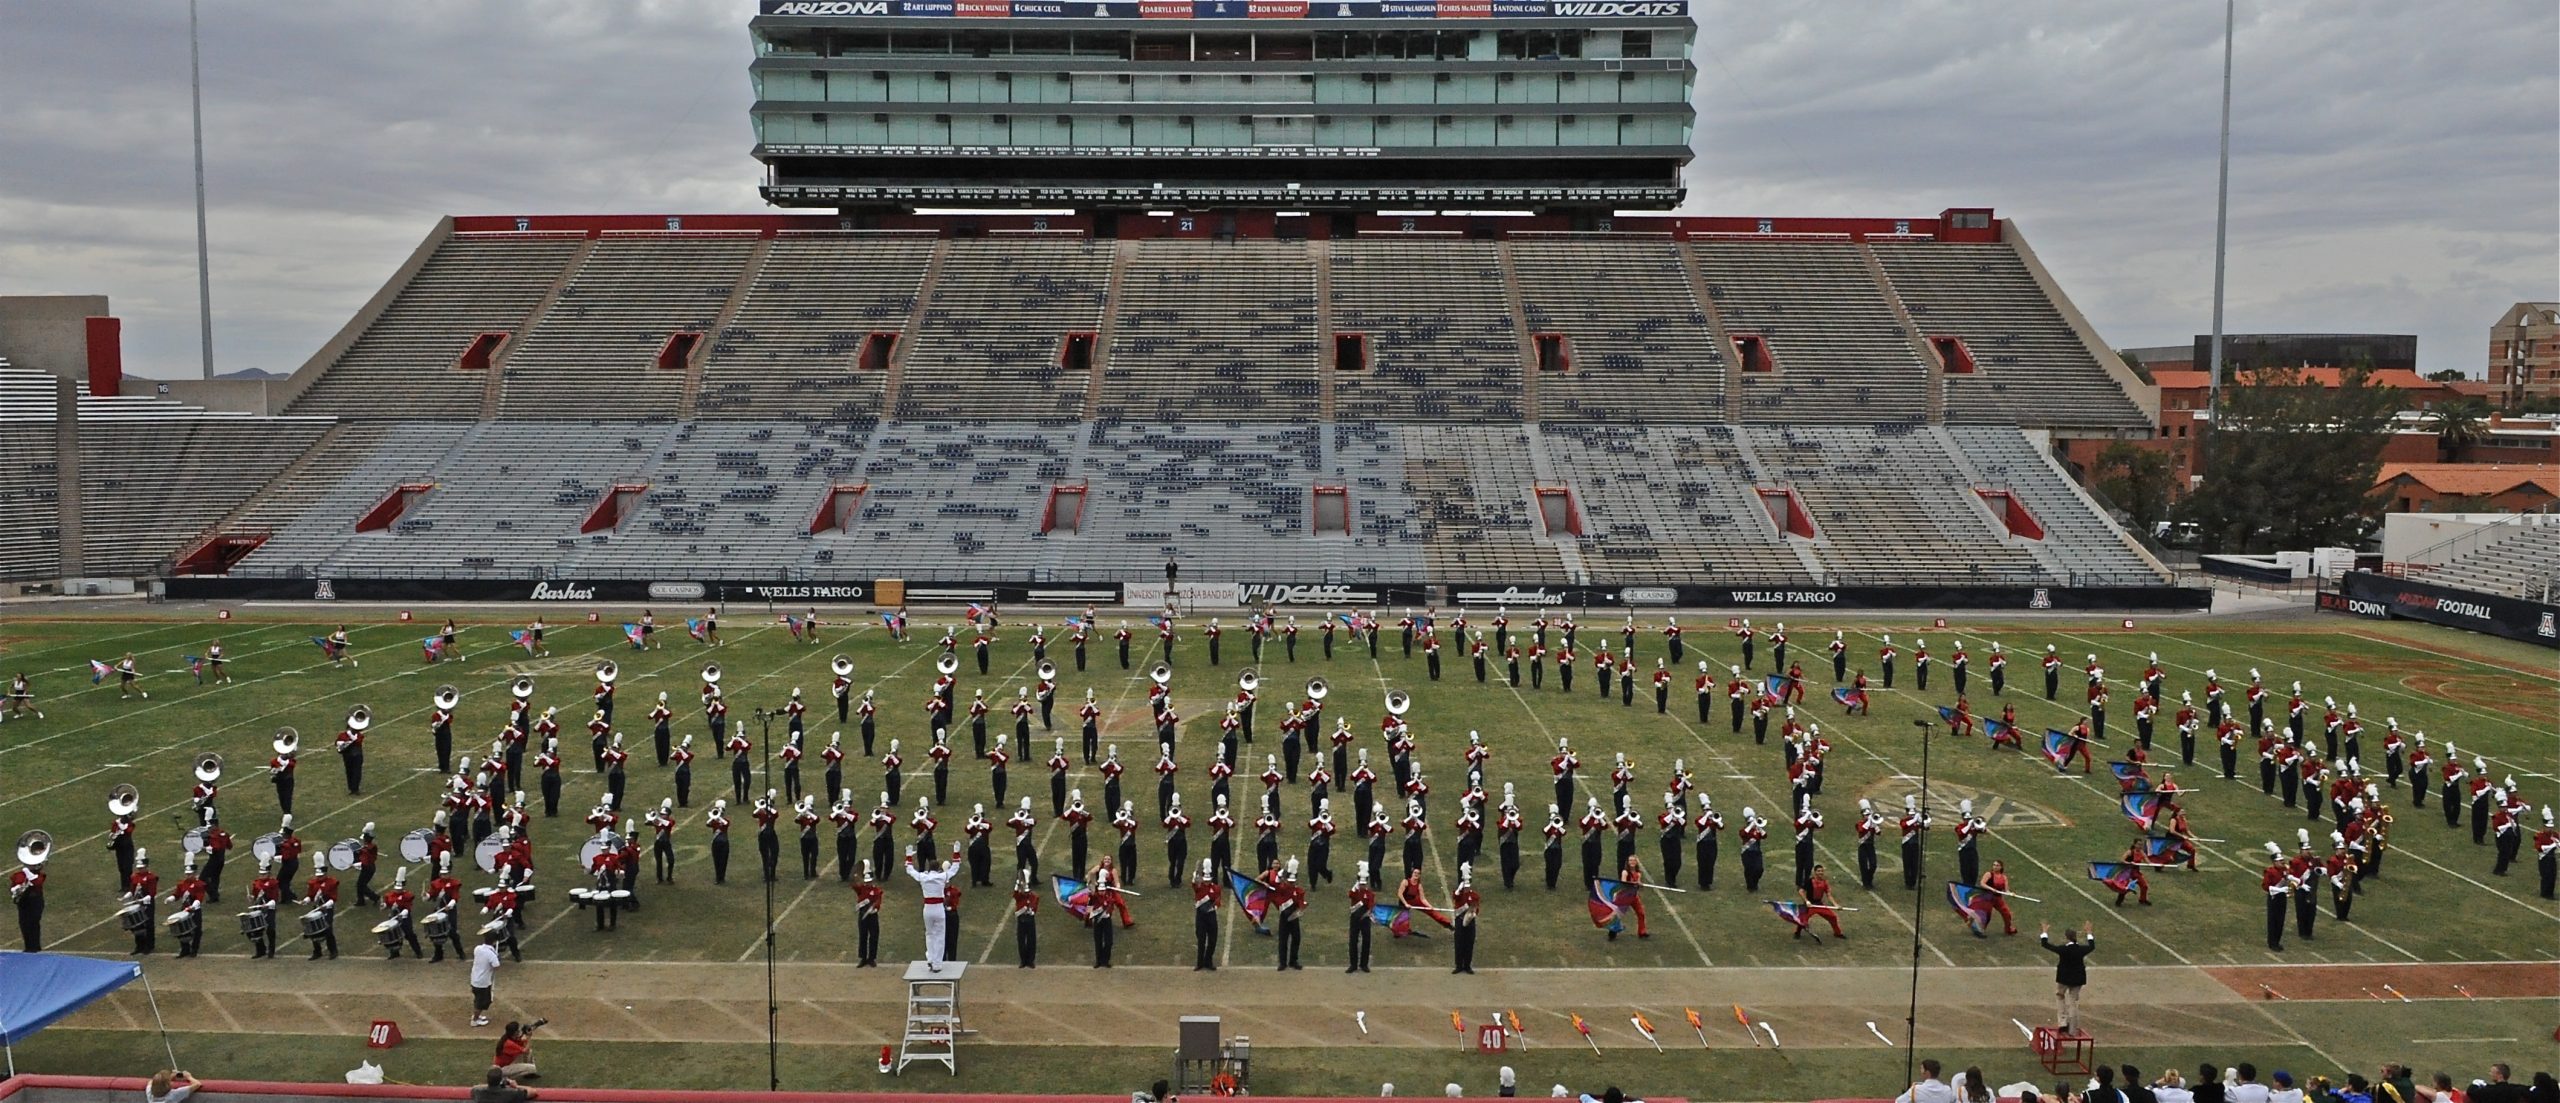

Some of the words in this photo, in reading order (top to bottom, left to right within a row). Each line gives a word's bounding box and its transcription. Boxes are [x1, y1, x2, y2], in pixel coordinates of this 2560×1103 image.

[773, 2, 888, 14] ARIZONA
[904, 3, 912, 11] 22
[1140, 5, 1144, 13] 4
[1555, 3, 1680, 15] WILDCATS
[518, 222, 528, 231] 17
[668, 222, 679, 232] 18
[1034, 221, 1047, 231] 20
[1182, 221, 1193, 230] 21
[1403, 223, 1415, 231] 22
[1599, 223, 1611, 232] 23
[1759, 224, 1771, 233] 24
[1896, 225, 1908, 234] 25
[159, 385, 168, 393] 16
[530, 582, 595, 600] Bashas'
[759, 586, 810, 597] WELLS
[813, 586, 863, 598] FARGO
[1127, 590, 1161, 599] UNIVERSITY
[1203, 590, 1221, 599] BAND
[1222, 590, 1235, 599] DAY
[1732, 592, 1783, 603] WELLS
[1786, 592, 1836, 603] FARGO
[2349, 600, 2385, 616] DOWN
[2436, 598, 2491, 619] FOOTBALL
[371, 1024, 389, 1044] 40
[1482, 1029, 1501, 1048] 40
